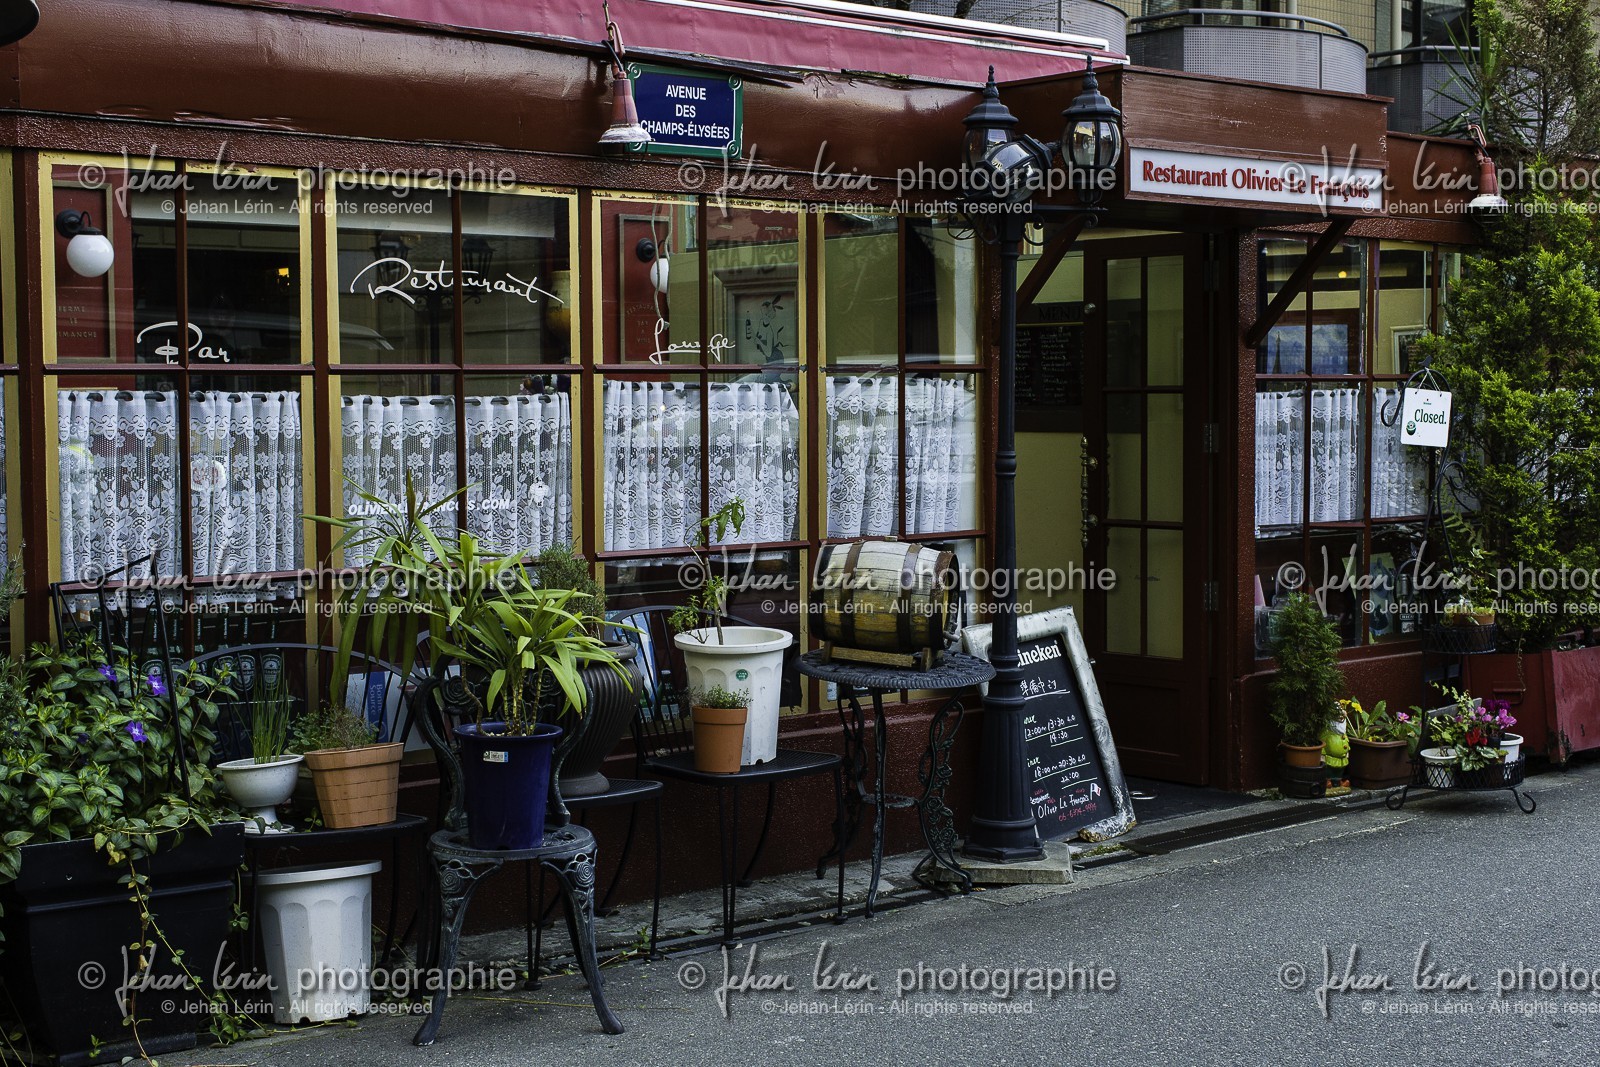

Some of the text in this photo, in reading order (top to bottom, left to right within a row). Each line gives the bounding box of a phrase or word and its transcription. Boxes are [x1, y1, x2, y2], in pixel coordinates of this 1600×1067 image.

[666, 84, 706, 100] AVENUE
[675, 104, 696, 118] DES
[640, 120, 730, 139] CHAMPS-ÉLYSÉES
[1143, 160, 1370, 202] Restaurant Olivier Le François
[350, 257, 564, 304] Restaurant
[1414, 409, 1447, 425] Closed.
[1018, 643, 1062, 667] ineken
